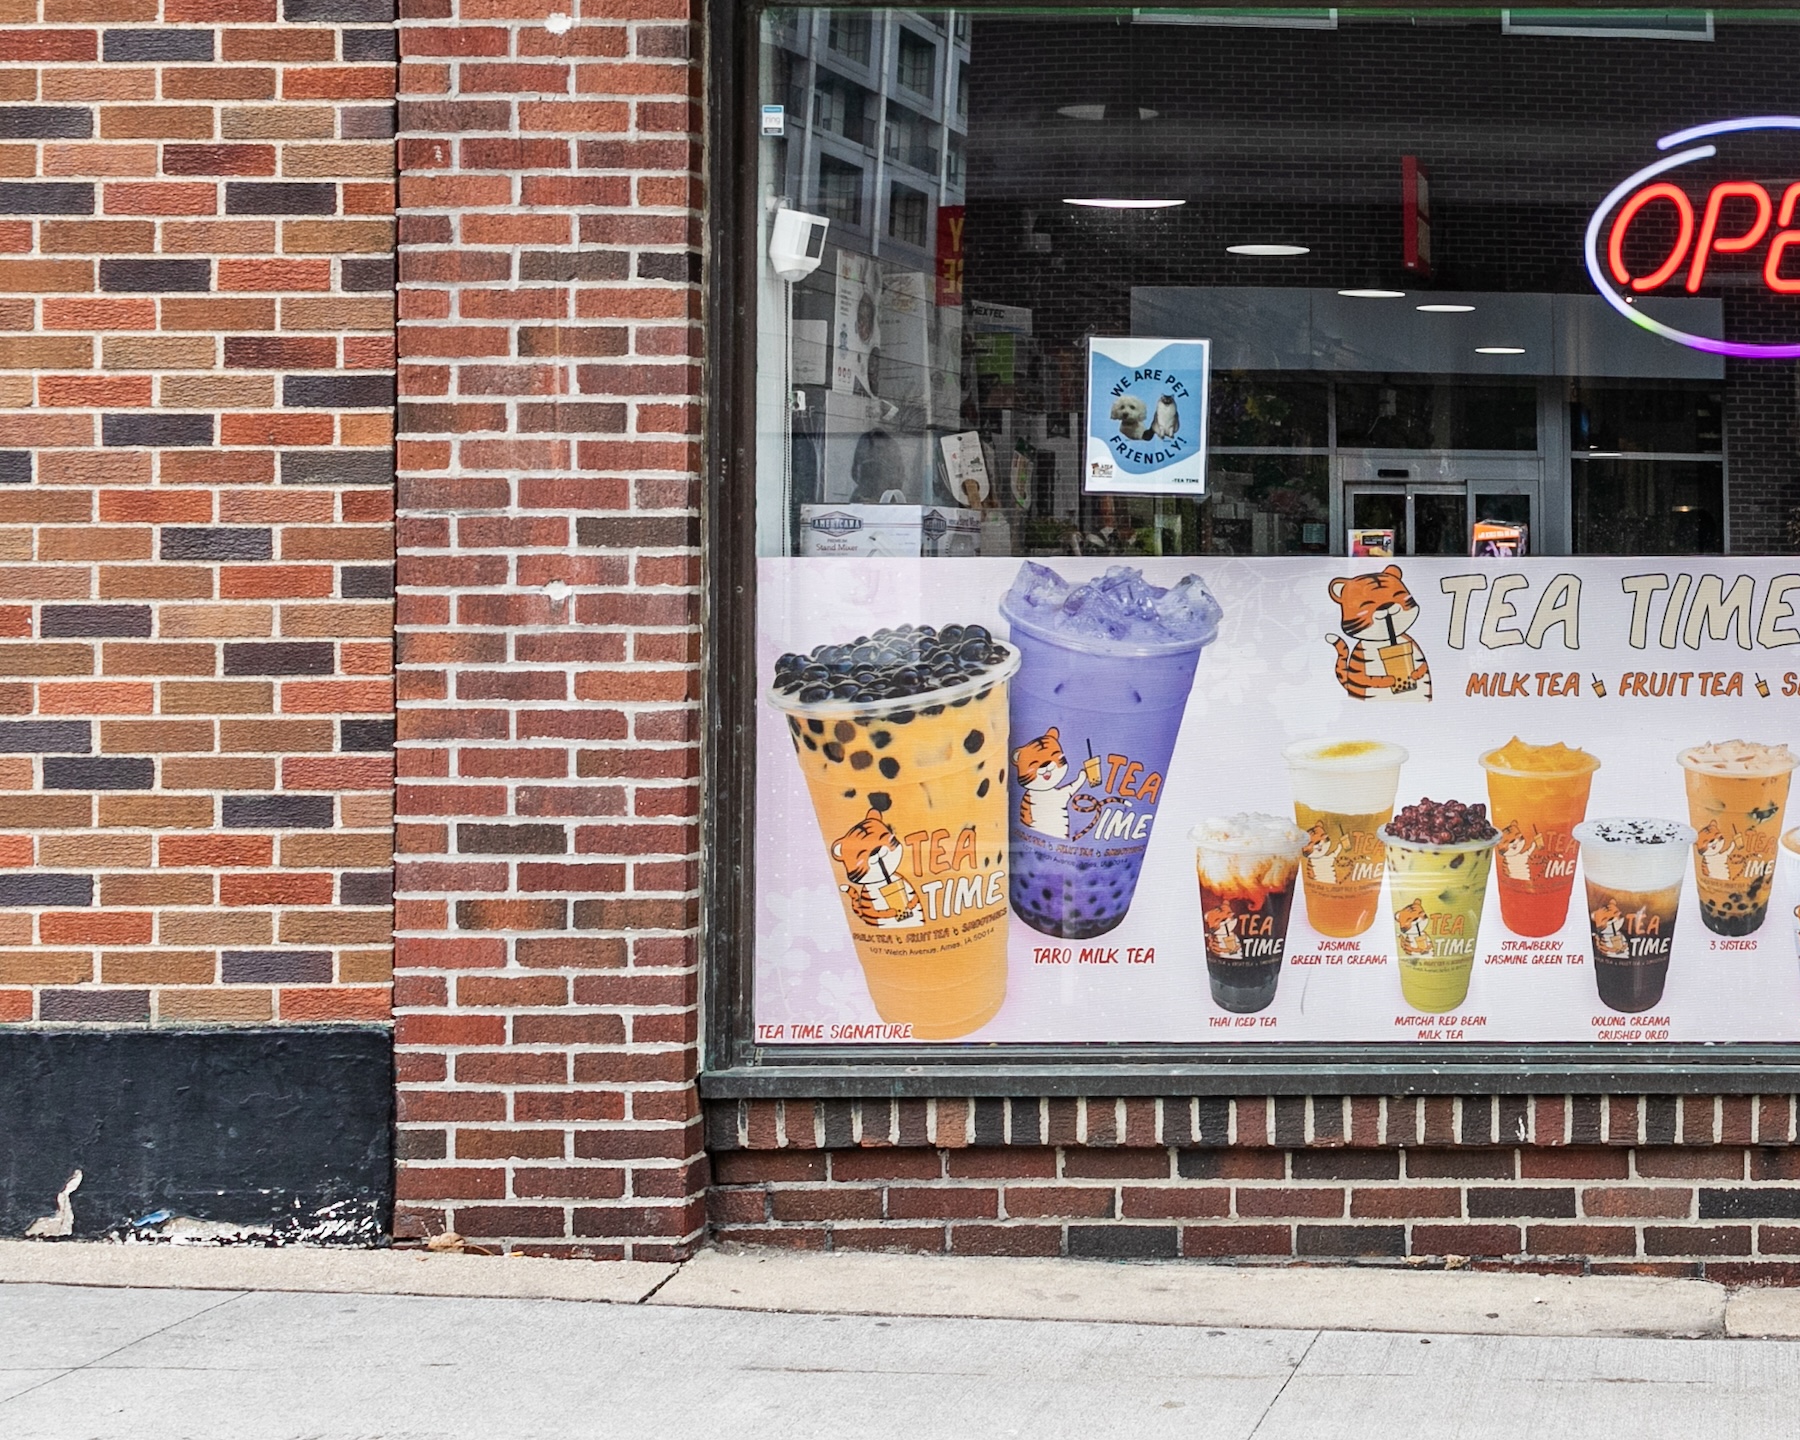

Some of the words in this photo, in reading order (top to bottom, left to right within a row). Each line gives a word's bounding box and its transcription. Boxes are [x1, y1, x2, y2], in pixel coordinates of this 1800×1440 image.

[1111, 377, 1131, 398] WE
[1134, 369, 1162, 382] ARE
[1165, 375, 1190, 399] PET
[1110, 435, 1188, 464] FRIENDLY!
[813, 519, 861, 529] AMERICANA
[1440, 574, 1582, 650] TEA
[1466, 672, 1528, 698] MILK
[1535, 672, 1580, 697] TEA
[1619, 672, 1696, 697] FRUIT
[1699, 672, 1743, 697] TEA
[1105, 754, 1162, 804] TEA
[1352, 831, 1383, 857] TEA
[1547, 831, 1577, 854] TEA
[1745, 830, 1776, 854] TEA
[905, 826, 977, 878] TEA
[922, 870, 1005, 921] TIME
[1239, 914, 1273, 936] TEA
[1430, 913, 1465, 936] TEA
[1626, 913, 1660, 935] TEA
[876, 933, 893, 943] TEA
[933, 928, 950, 939] TEA
[1243, 938, 1284, 958] TIME
[1317, 941, 1361, 951] JASMINE
[1435, 938, 1475, 957] TIME
[1501, 941, 1563, 951] STRAWBERRY
[1630, 938, 1670, 957] TIME
[1710, 940, 1716, 951] 3
[1720, 940, 1757, 951] SISTERS
[1033, 948, 1072, 964] TARO
[1078, 948, 1120, 964] MILK
[1126, 948, 1155, 964] TEA
[1290, 954, 1321, 965] GREEN
[1324, 954, 1343, 965] TEA
[1347, 954, 1387, 965] CREAMA
[1485, 954, 1527, 964] JASMINE
[1531, 954, 1563, 964] GREEN
[1566, 954, 1584, 964] TEA
[1208, 1016, 1231, 1027] THAI
[1234, 1016, 1256, 1027] ICED
[1260, 1016, 1277, 1027] TEA
[1394, 1016, 1435, 1026] MATCHA
[1439, 1016, 1458, 1026] RED
[1461, 1016, 1487, 1026] BEAN
[1591, 1016, 1626, 1026] OOLONG
[1630, 1016, 1670, 1026] CREAMA
[758, 1023, 787, 1040] TEA
[790, 1023, 824, 1040] TIME
[830, 1023, 912, 1040] SIGNATURE
[1418, 1029, 1440, 1040] MILK
[1443, 1029, 1463, 1040] TEA
[1598, 1029, 1639, 1040] CRUSHED
[1642, 1029, 1669, 1040] OREO
